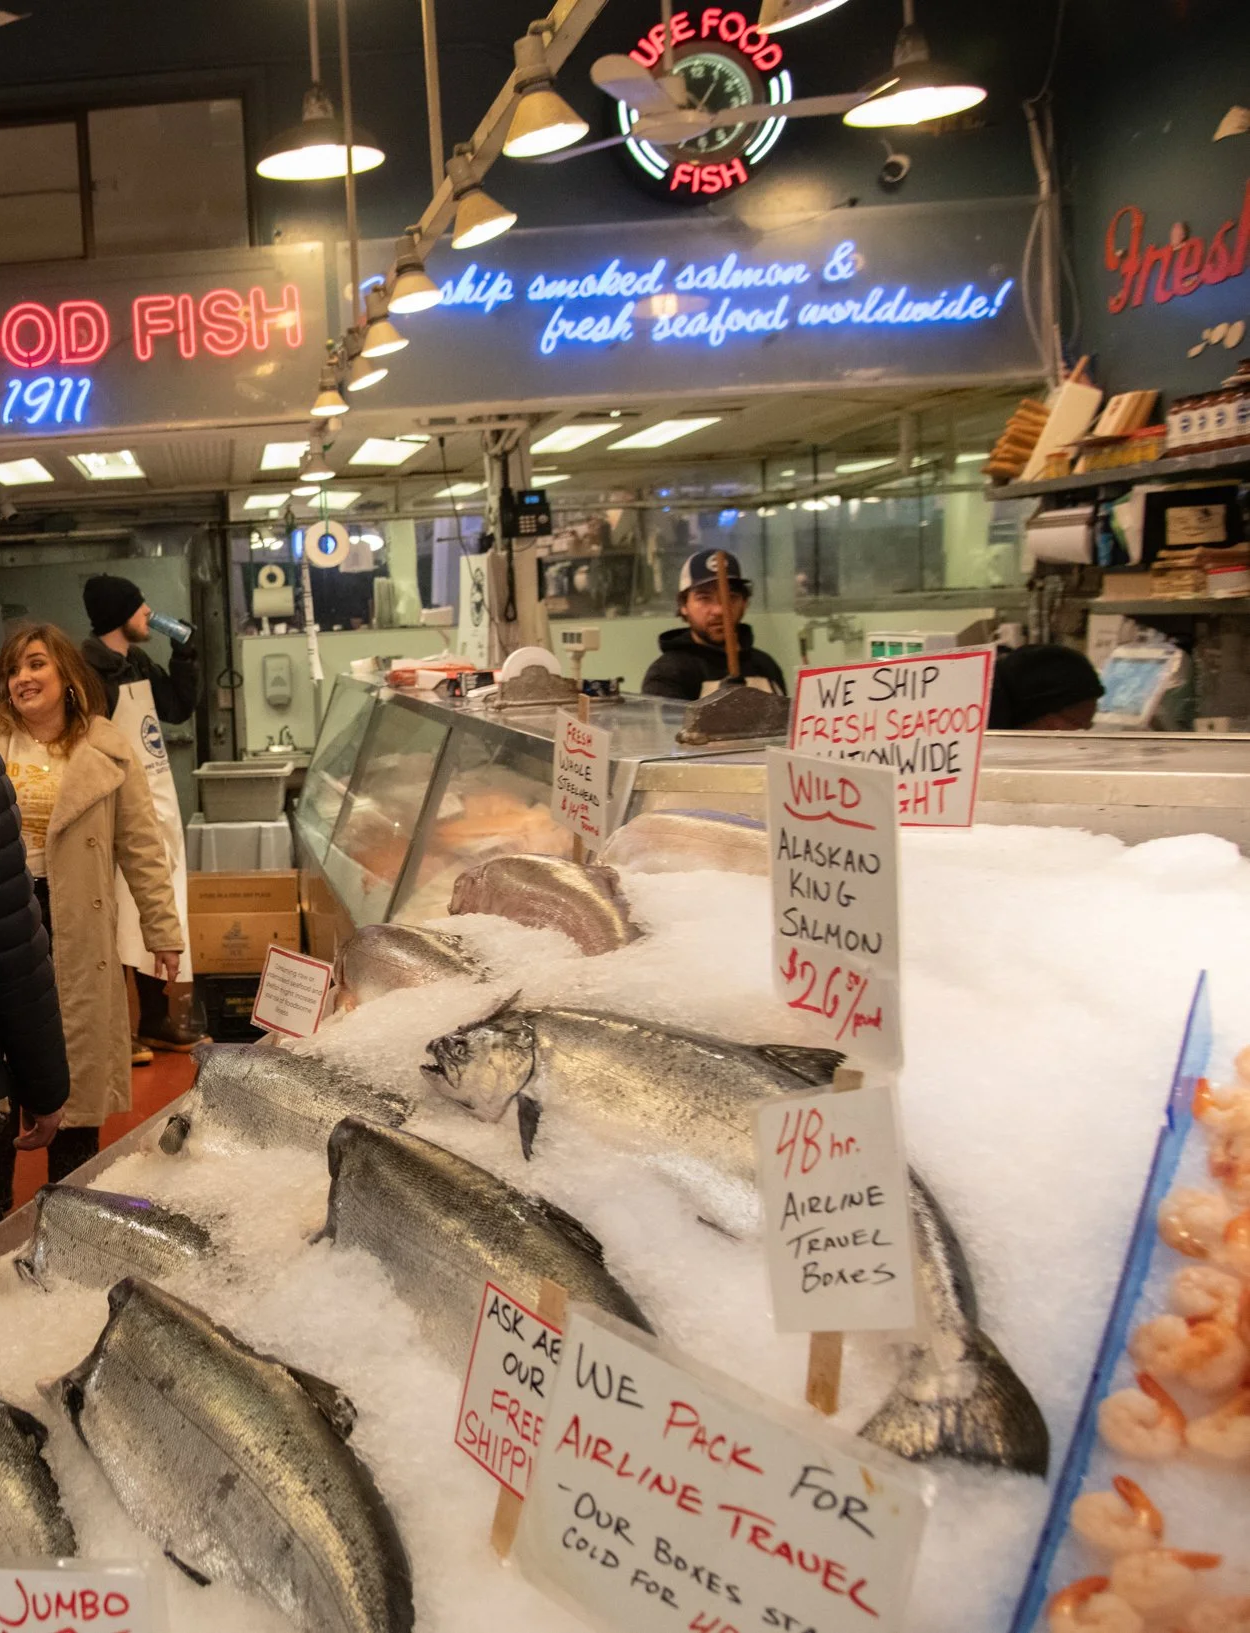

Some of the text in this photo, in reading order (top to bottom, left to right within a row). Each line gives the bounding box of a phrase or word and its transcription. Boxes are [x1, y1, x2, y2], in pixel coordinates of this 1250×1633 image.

[628, 7, 783, 194] URE FOOD FISH
[440, 239, 856, 314] ship smoked salmon &
[133, 283, 303, 362] FISH
[540, 277, 1014, 356] fresh seafood worldwide!
[2, 376, 91, 425] 1911
[817, 666, 940, 709] WE SHIP
[566, 721, 593, 747] FRESH
[798, 703, 983, 746] FRESH SEAFOOD
[558, 750, 593, 782] WHOLE
[787, 761, 862, 810] WILD
[777, 827, 880, 876] ALASKAN
[789, 866, 856, 908] KING
[779, 906, 883, 955] SALMON
[776, 1107, 862, 1179] 48 hr.
[780, 1185, 885, 1231] AIRLINE
[786, 1226, 893, 1259] TRAVEL
[487, 1296, 525, 1342] ASK
[503, 1352, 545, 1399] OUR
[490, 1388, 544, 1447] FREE
[575, 1342, 876, 1539] WE PACK FOR
[555, 1414, 881, 1618] AIRLINE TRAVEL
[561, 1526, 620, 1570] COLD
[630, 1568, 679, 1610] FOR
[654, 1536, 743, 1606] BOXES
[761, 1606, 818, 1633] ST
